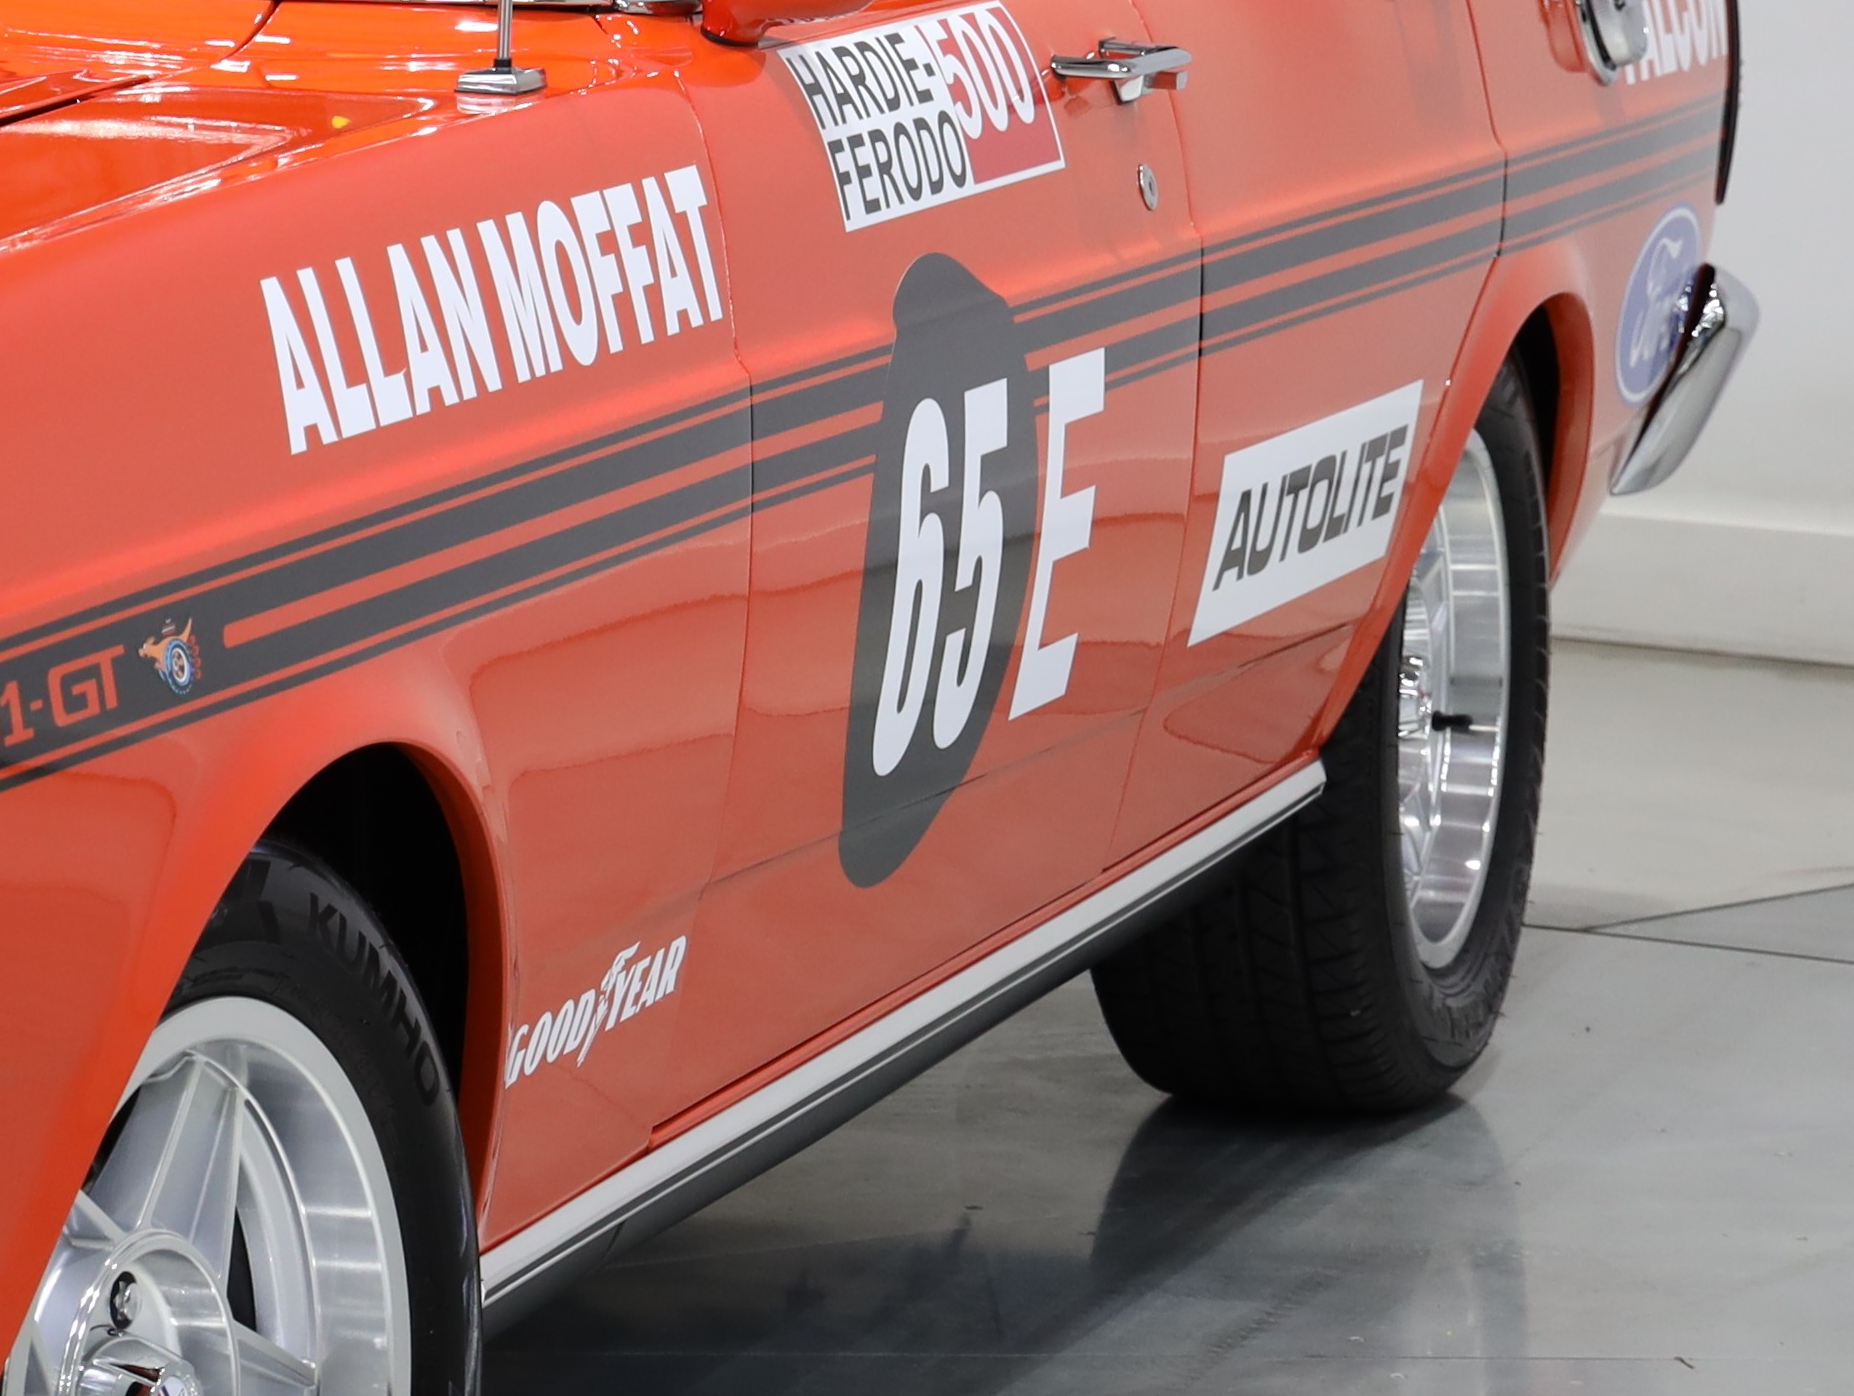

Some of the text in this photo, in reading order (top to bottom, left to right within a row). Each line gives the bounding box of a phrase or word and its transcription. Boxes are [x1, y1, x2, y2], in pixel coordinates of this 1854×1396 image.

[926, 7, 1036, 140] 500
[827, 109, 968, 221] FERODO
[259, 163, 724, 455] ALLAN MOFFAT
[872, 346, 1106, 777] 65 E
[1210, 424, 1409, 593] AUTOLITE
[308, 891, 441, 1107] KUMHO
[504, 934, 687, 1090] GOODYEAR
